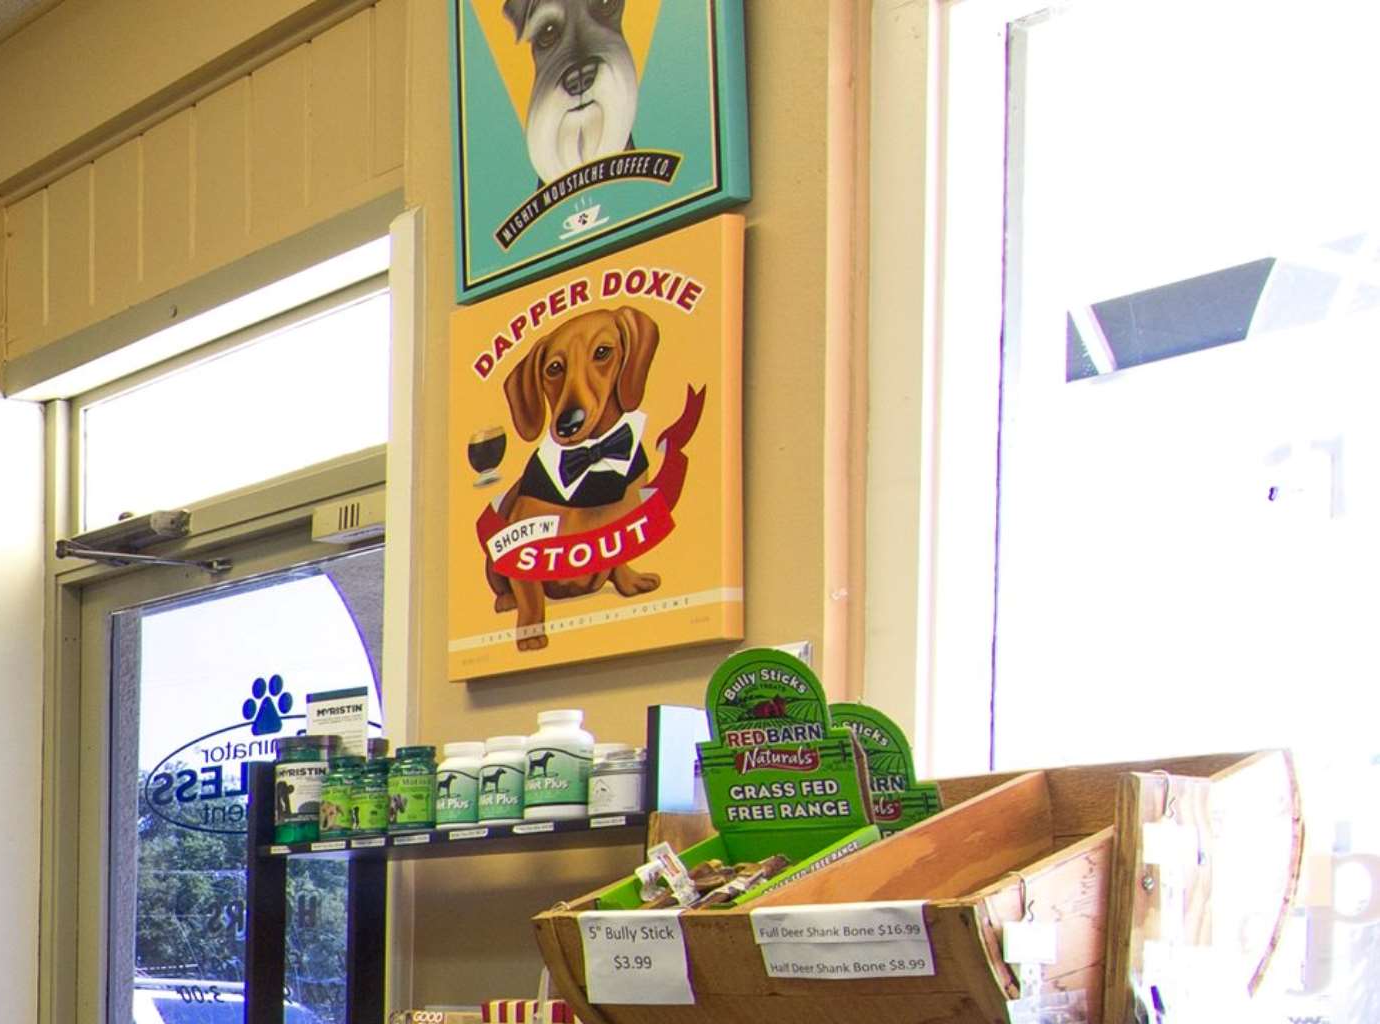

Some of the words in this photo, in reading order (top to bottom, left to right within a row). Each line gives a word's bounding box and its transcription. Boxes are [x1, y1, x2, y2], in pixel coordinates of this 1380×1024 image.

[501, 203, 540, 243] MIGHTY
[543, 163, 604, 207] MOUSTACHE
[609, 156, 650, 177] COFFEE
[652, 158, 670, 177] CO.
[473, 279, 591, 379] DAPPER
[600, 268, 704, 313] DOXIE
[494, 522, 536, 553] SHORT
[516, 516, 650, 572] STOUT
[724, 672, 755, 702] Bully
[760, 668, 808, 694] Sticks
[316, 703, 364, 717] MYRISTIN
[727, 724, 823, 749] REDBARN
[842, 720, 890, 747] Sticks
[741, 747, 818, 774] Naturals
[544, 778, 570, 790] Plus
[729, 782, 795, 800] GRASS
[801, 779, 839, 797] FED
[495, 794, 520, 806] Plus
[727, 805, 776, 821] FREE
[780, 800, 851, 818] RANGE
[589, 924, 603, 940] 5"
[605, 926, 638, 943] Bully
[641, 925, 674, 940] Stick
[759, 926, 782, 939] Full
[783, 927, 805, 938] Deer
[807, 926, 840, 938] Shank
[843, 925, 875, 938] Bone
[877, 923, 922, 938] $16.99
[613, 954, 654, 971] $3.99
[769, 962, 791, 974] Half
[791, 962, 815, 974] Deer
[816, 961, 850, 974] Shank
[853, 960, 887, 973] Bone
[888, 958, 928, 973] $8.99
[413, 1010, 443, 1023] GOOD
